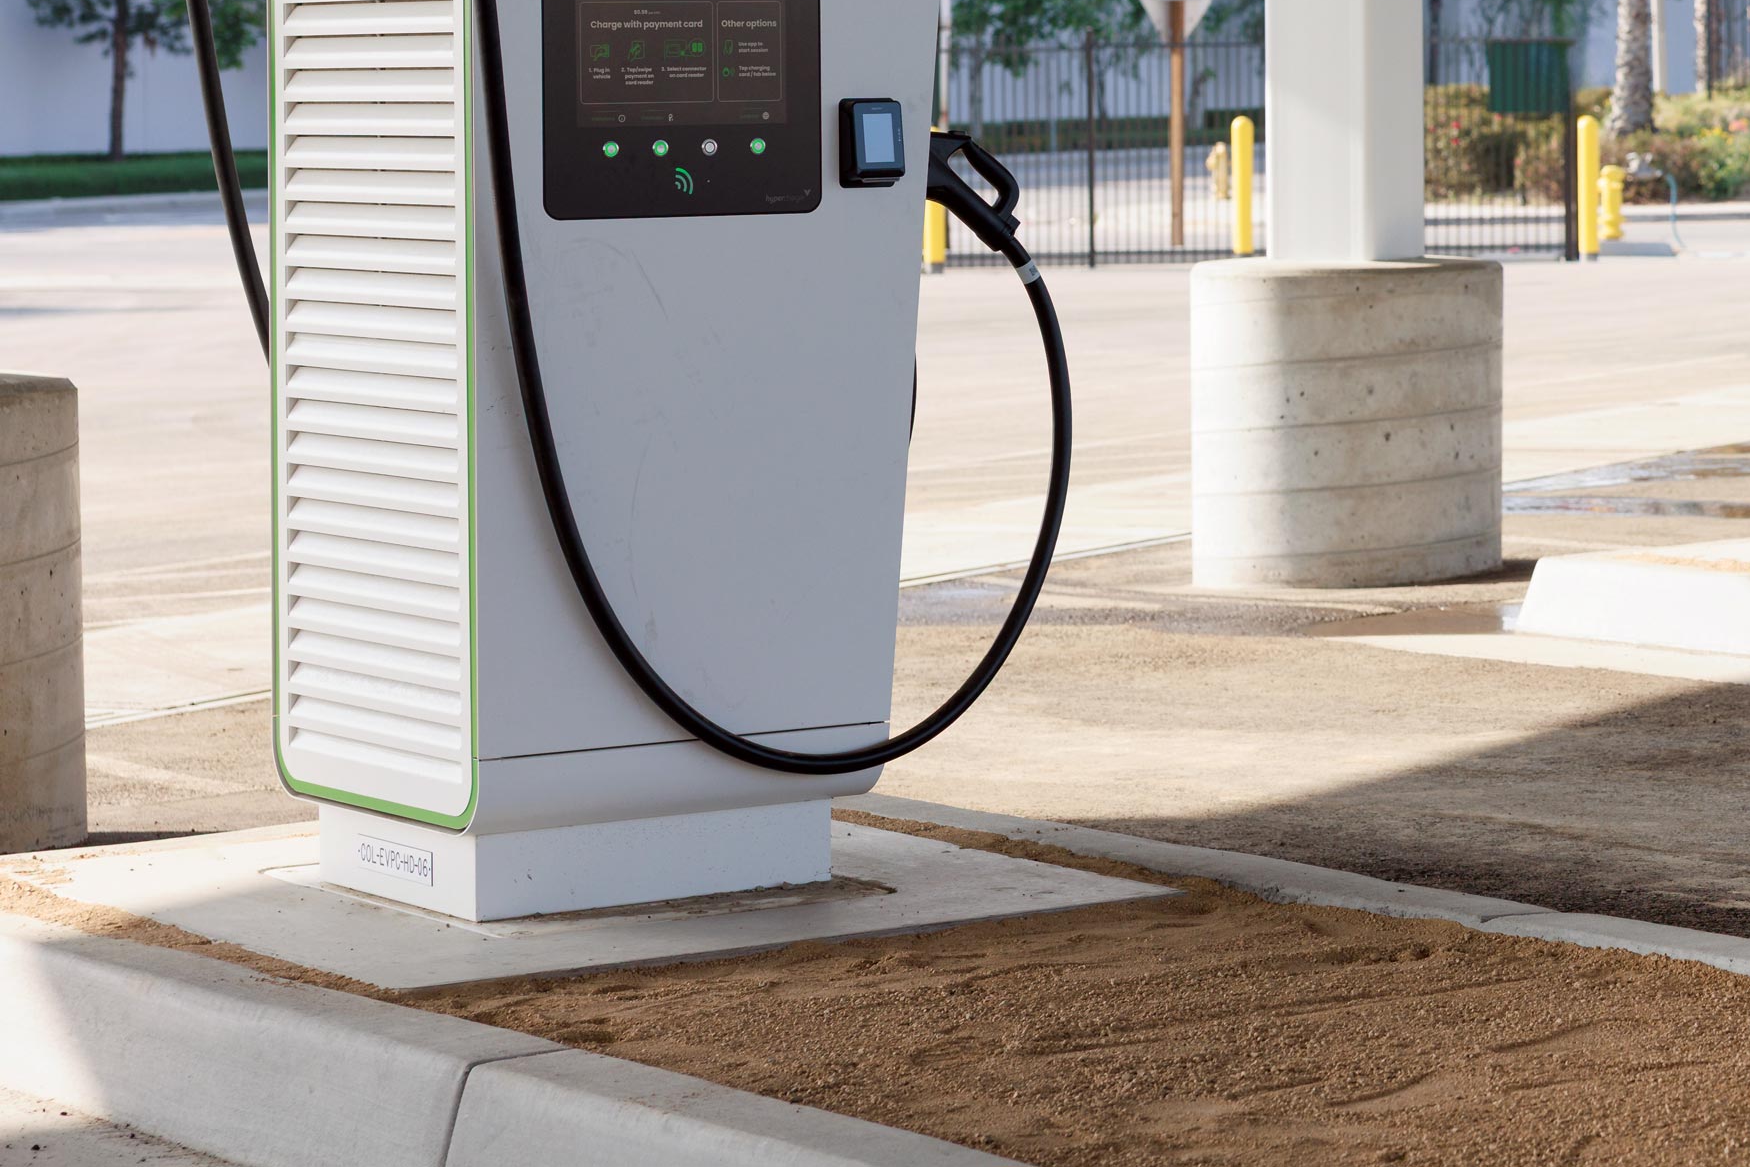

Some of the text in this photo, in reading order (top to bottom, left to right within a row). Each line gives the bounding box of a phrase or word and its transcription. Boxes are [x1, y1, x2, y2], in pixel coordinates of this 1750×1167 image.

[590, 19, 704, 31] Charge with payment card
[721, 18, 777, 30] Other options
[360, 843, 429, 877] COL-EVPC-HD-06
